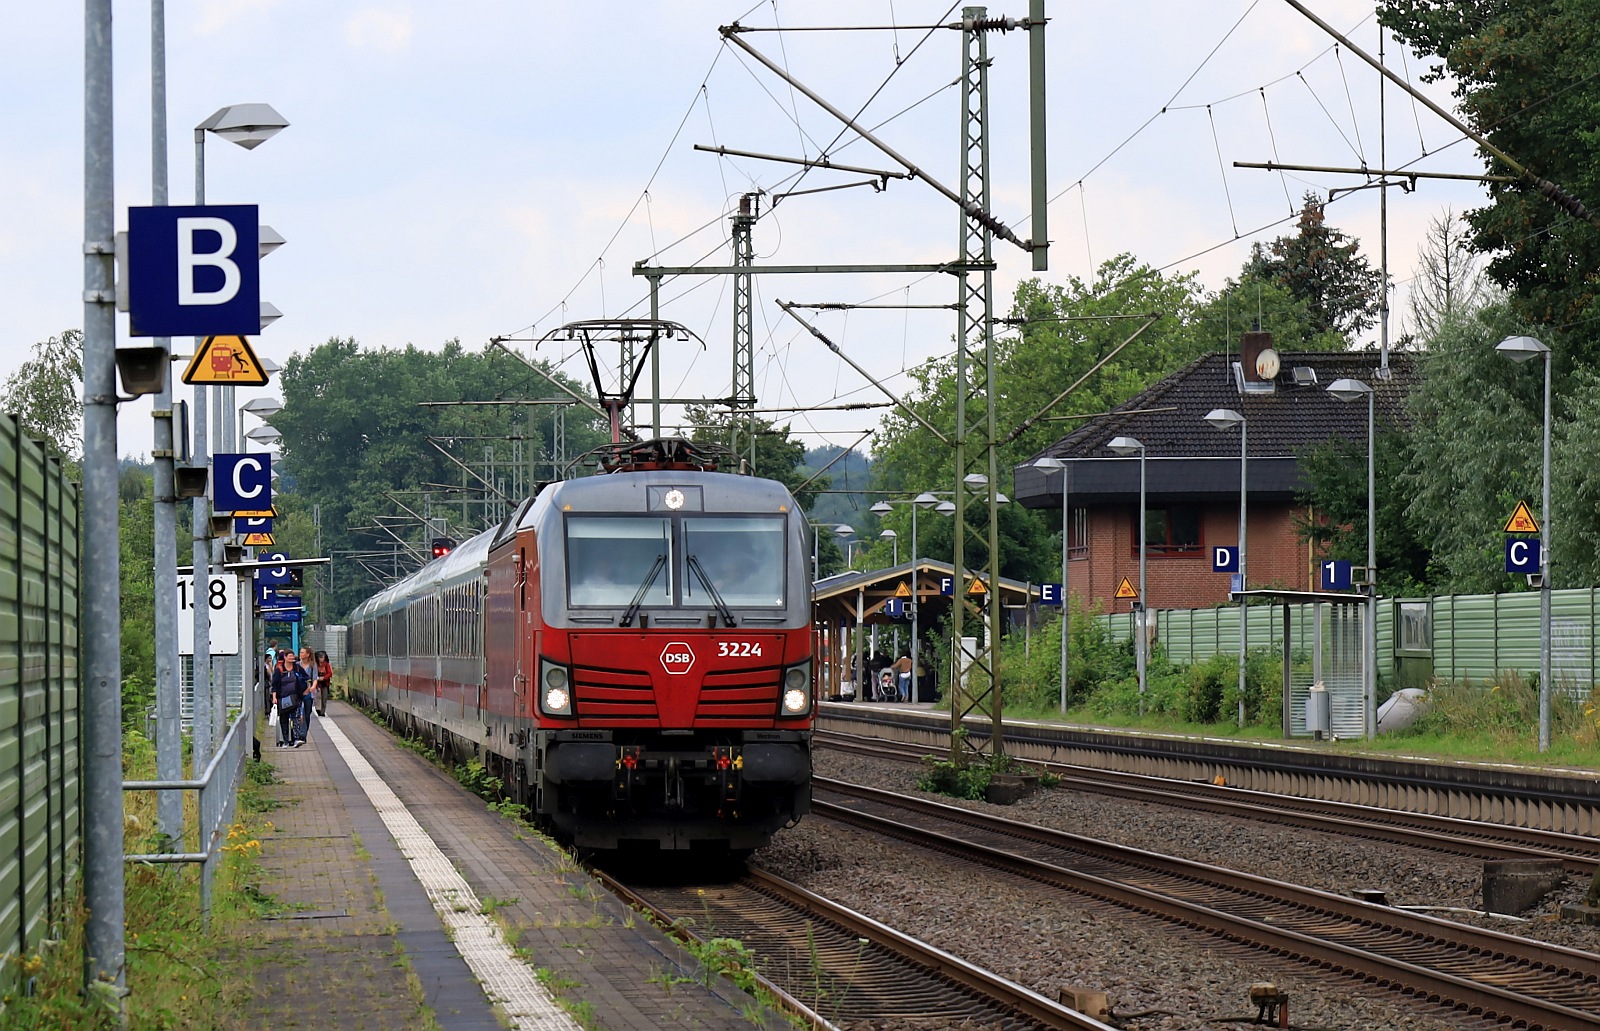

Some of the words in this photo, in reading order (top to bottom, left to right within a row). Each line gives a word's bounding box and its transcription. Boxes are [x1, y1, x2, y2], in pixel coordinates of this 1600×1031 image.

[177, 217, 241, 306] B
[233, 458, 263, 498] C
[1216, 548, 1230, 567] D
[1510, 541, 1528, 565] C
[271, 554, 286, 578] 3
[1325, 561, 1335, 583] 1
[177, 579, 227, 610] 18
[942, 578, 950, 591] F
[1042, 585, 1053, 600] E
[888, 599, 895, 612] 1
[665, 653, 690, 663] DSB
[718, 642, 762, 657] 3224
